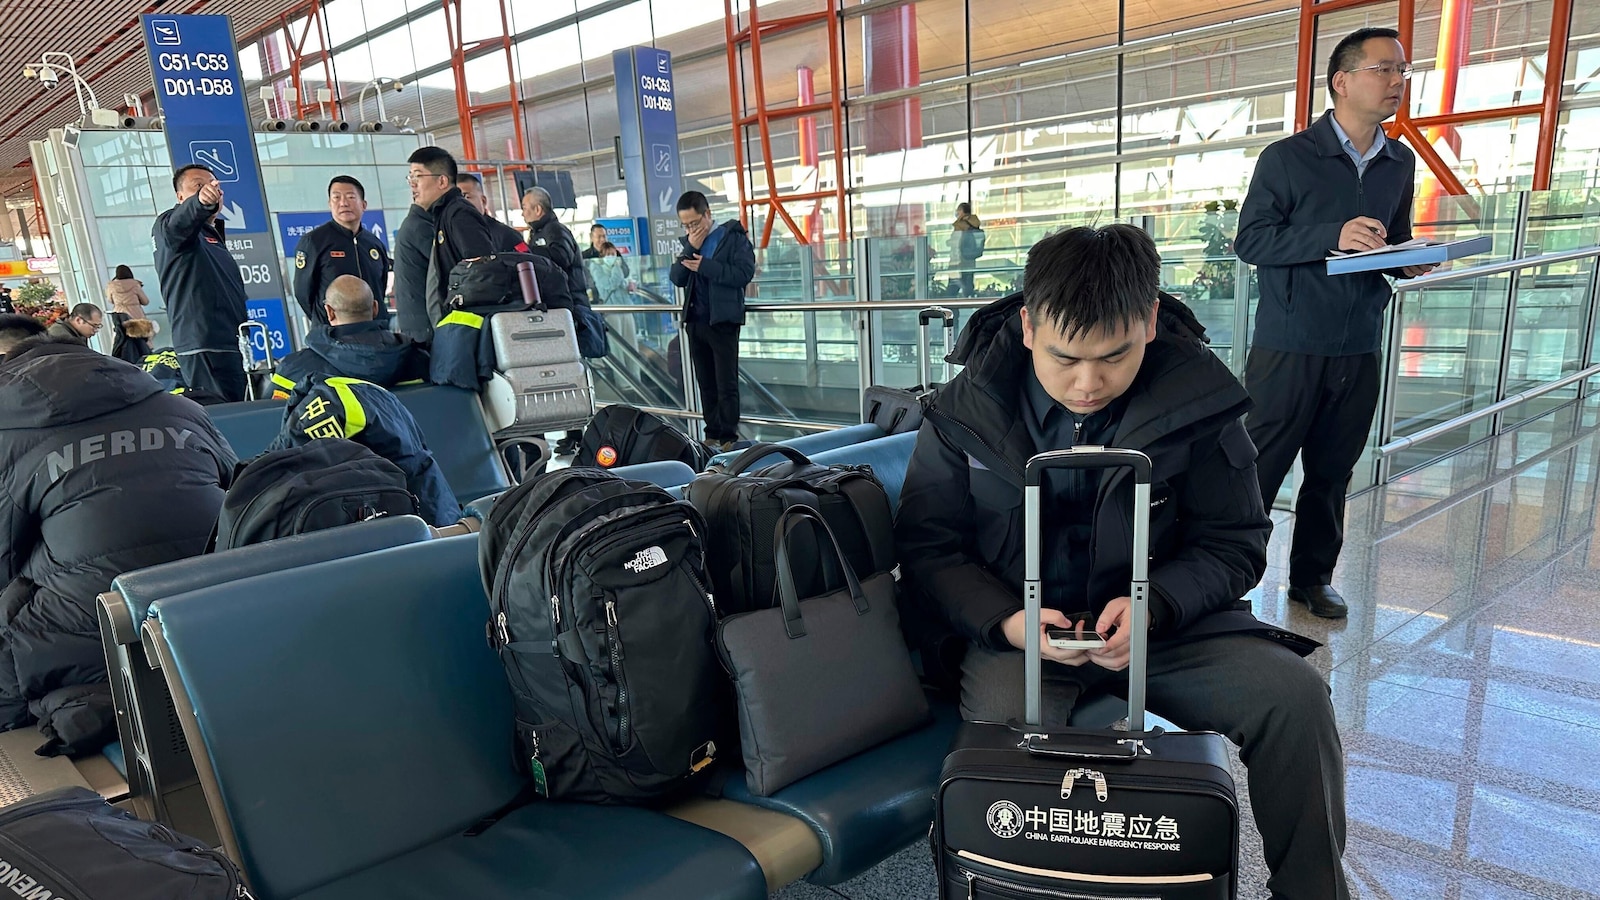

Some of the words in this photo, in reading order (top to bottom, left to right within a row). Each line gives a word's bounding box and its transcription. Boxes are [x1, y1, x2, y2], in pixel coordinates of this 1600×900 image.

[159, 52, 229, 71] C51-C53
[164, 78, 234, 96] D01-D58
[641, 75, 671, 92] C51-C53
[643, 94, 672, 111] D01-D58
[247, 308, 267, 319] 机口
[47, 427, 192, 484] NERDY
[624, 553, 652, 570] NORTH
[635, 547, 651, 559] THE
[633, 560, 655, 573] FACE
[1025, 805, 1180, 841] 中国地震应急
[1025, 831, 1048, 842] CHINA
[1050, 834, 1098, 846] EARTHQUAKE
[1098, 838, 1143, 849] EMERGENCY
[1143, 841, 1180, 851] RESPONSE
